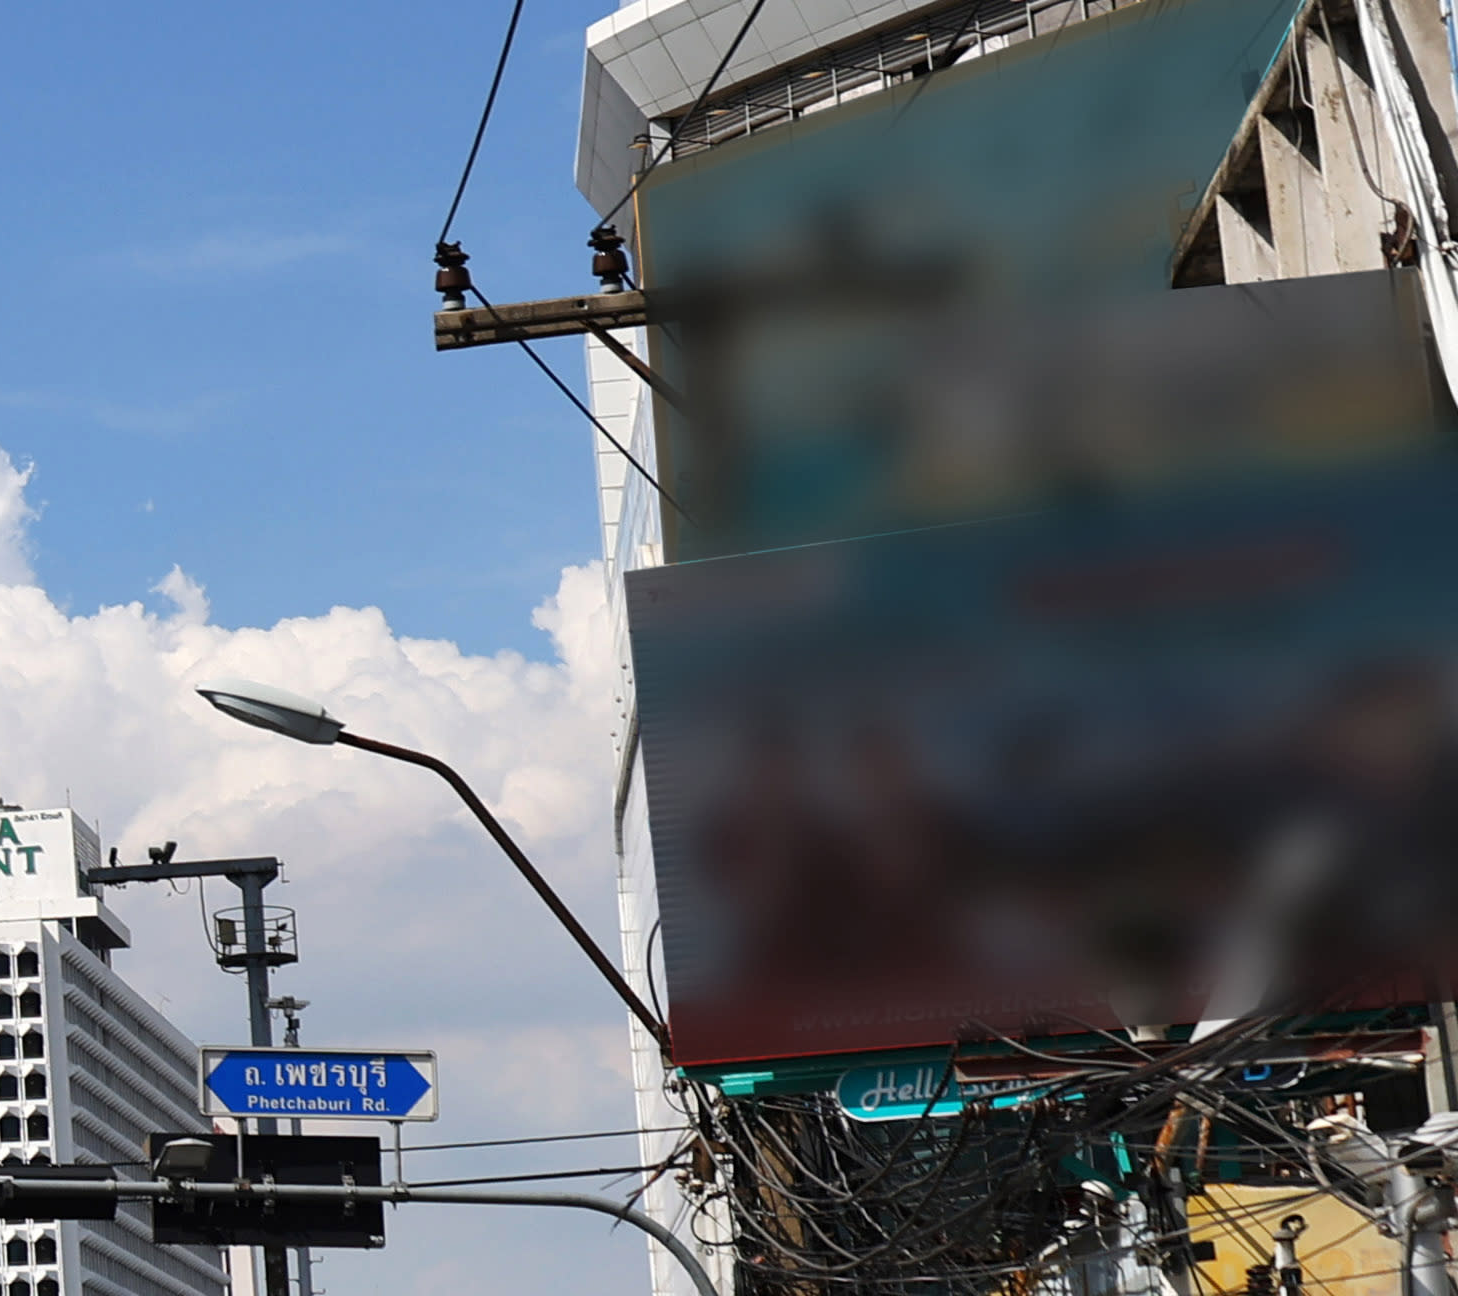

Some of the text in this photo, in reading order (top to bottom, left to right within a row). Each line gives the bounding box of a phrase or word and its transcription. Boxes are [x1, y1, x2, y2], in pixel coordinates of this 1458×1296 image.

[244, 1058, 387, 1096] ถ. เพชรบุรี
[247, 1094, 390, 1112] Phetchaburi Rd.
